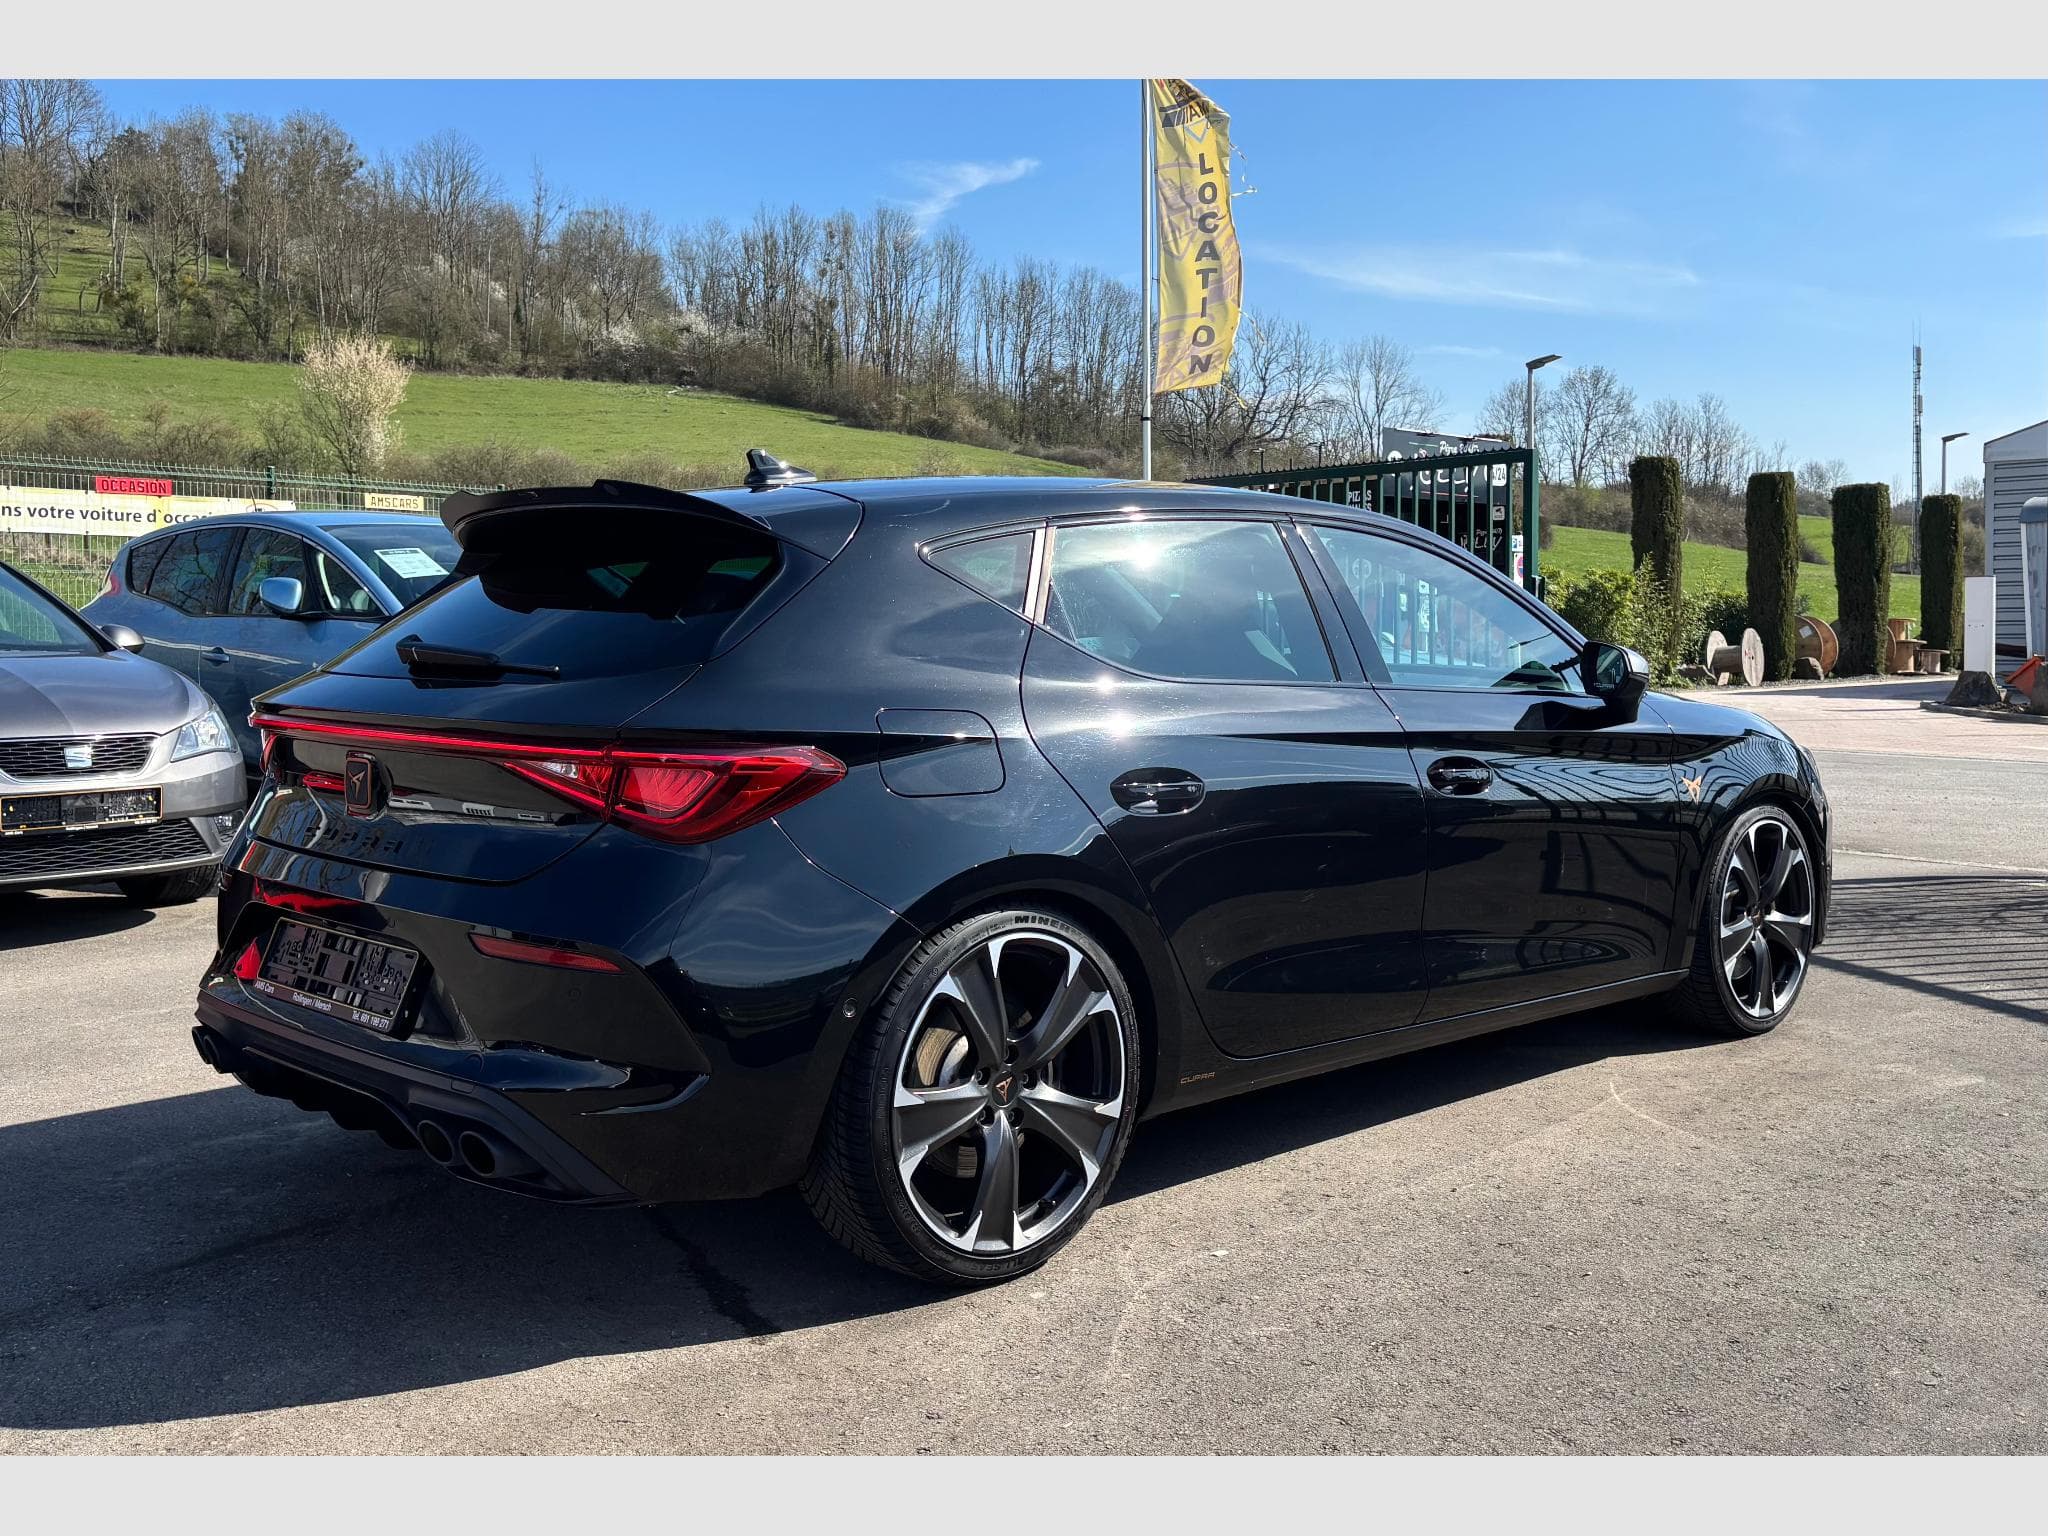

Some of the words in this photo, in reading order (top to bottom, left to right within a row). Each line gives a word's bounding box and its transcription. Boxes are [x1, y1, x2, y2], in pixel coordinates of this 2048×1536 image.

[1188, 153, 1219, 375] LOCATION
[101, 480, 167, 494] OCCASION
[27, 506, 75, 519] votre
[80, 506, 147, 523] voiture
[1180, 1071, 1216, 1084] CUPRA
